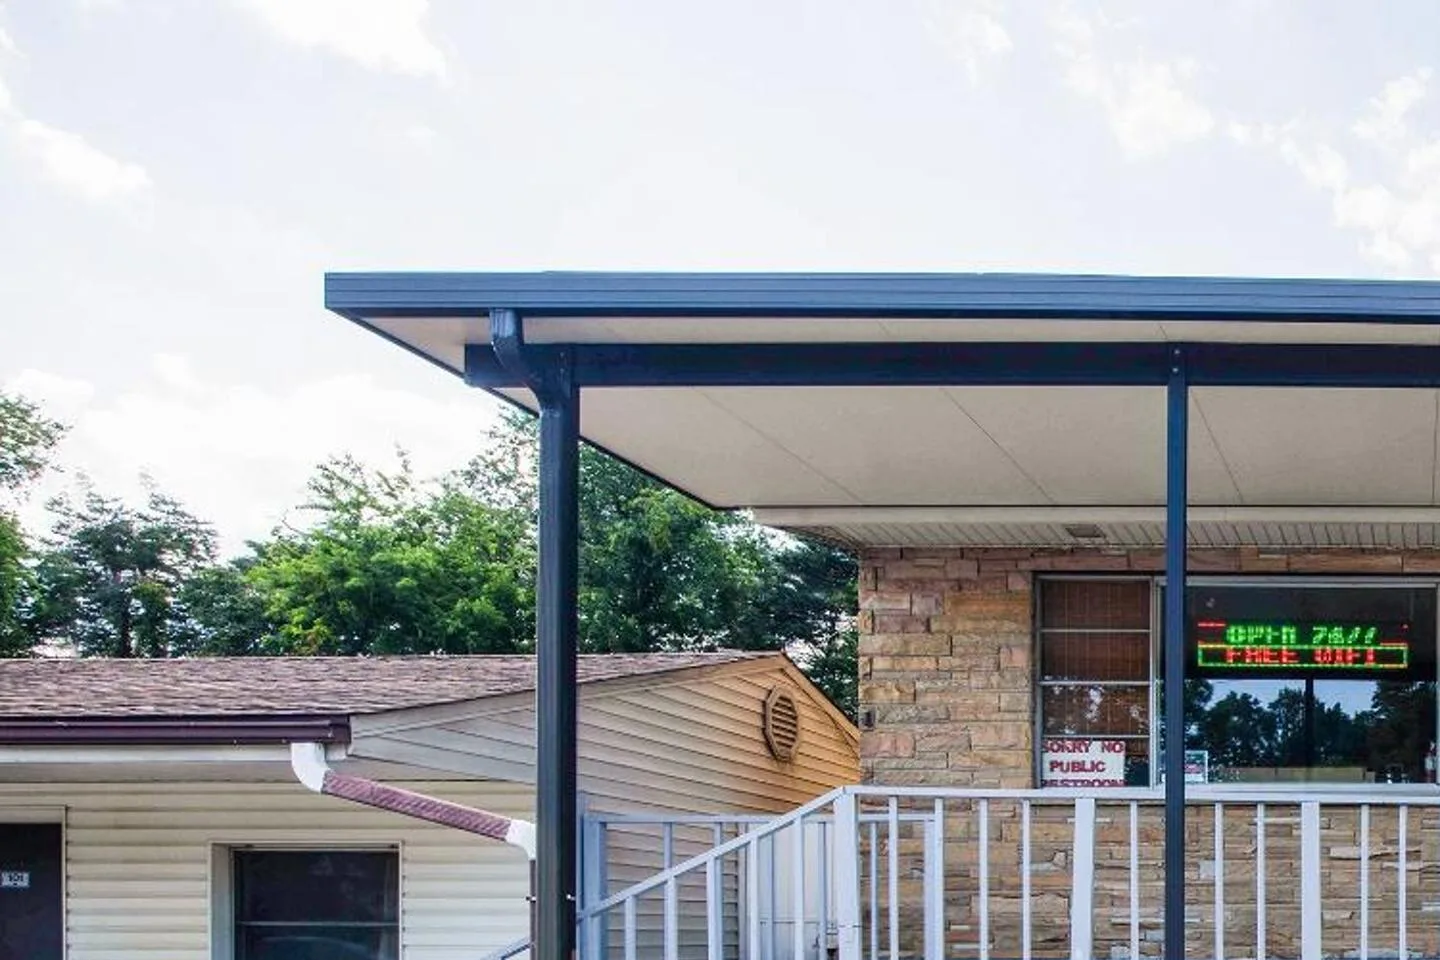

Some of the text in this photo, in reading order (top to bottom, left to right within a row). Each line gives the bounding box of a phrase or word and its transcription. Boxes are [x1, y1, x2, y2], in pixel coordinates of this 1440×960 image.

[1226, 625, 1297, 644] OPEN
[1226, 646, 1299, 664] FREE
[1042, 738, 1125, 753] SORRY NO
[1049, 760, 1106, 773] PUBLIC
